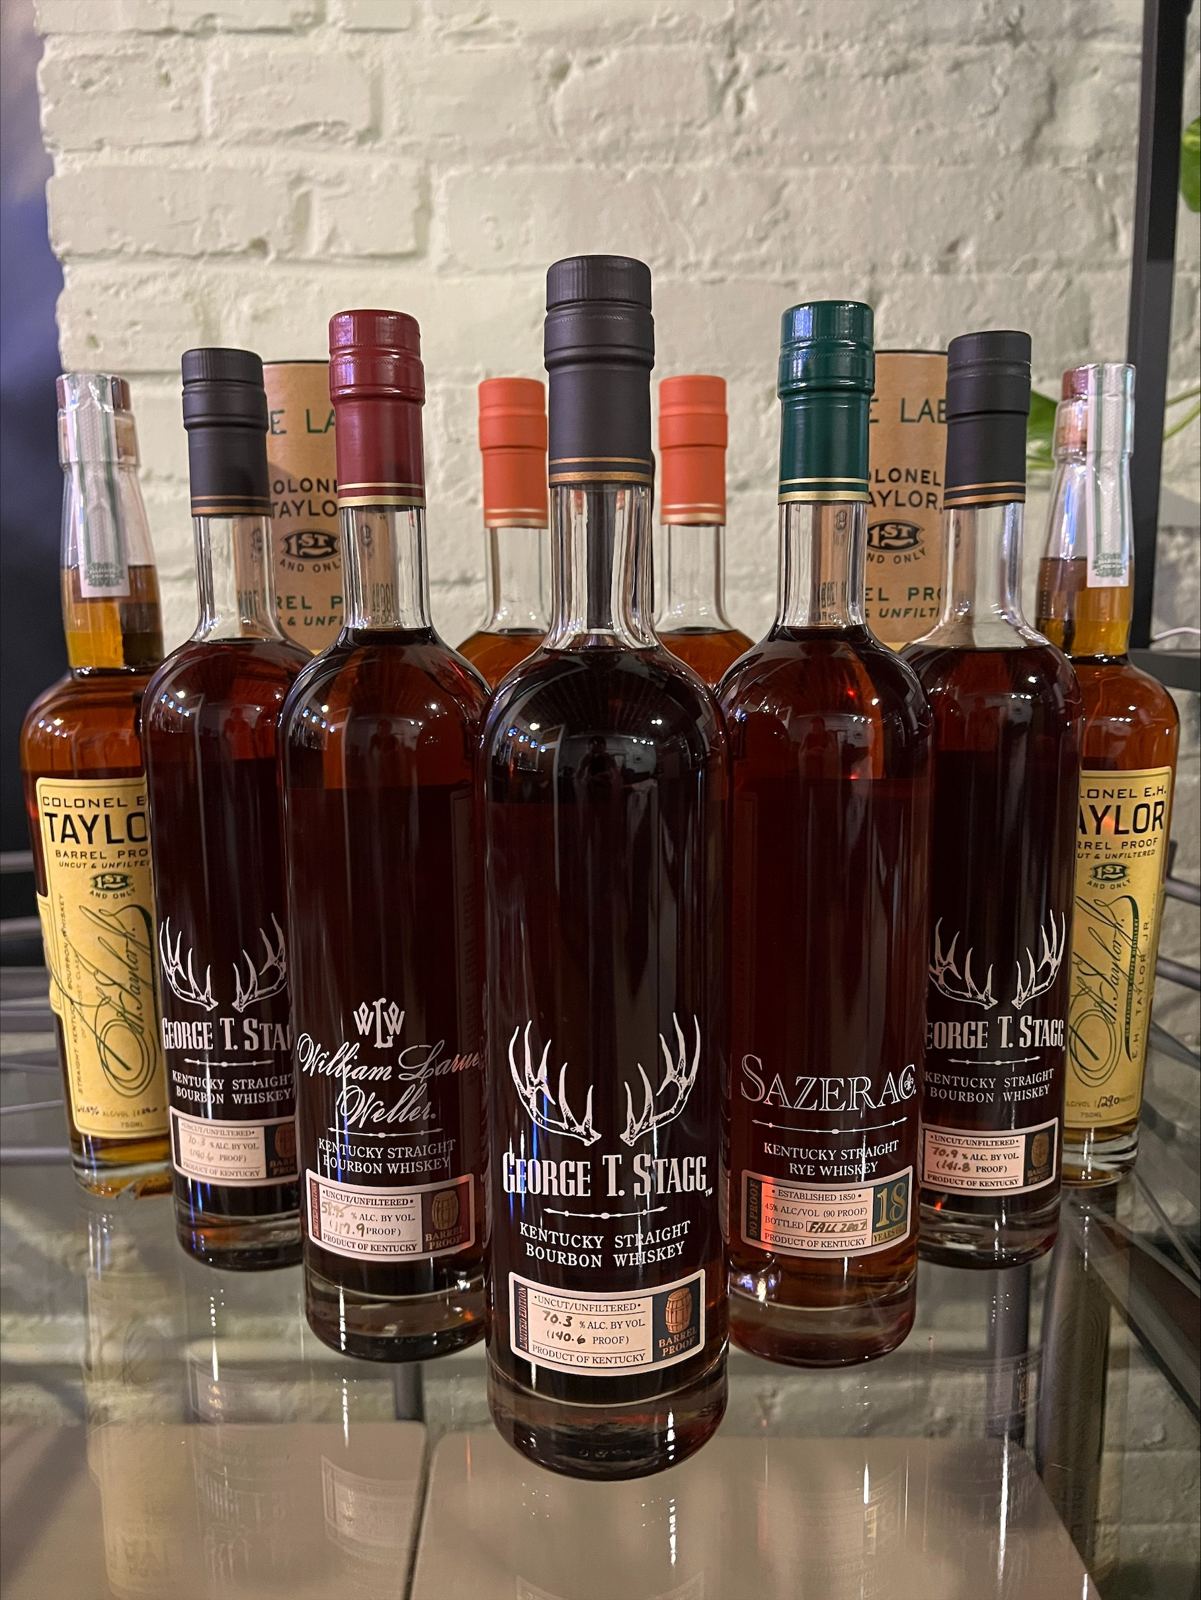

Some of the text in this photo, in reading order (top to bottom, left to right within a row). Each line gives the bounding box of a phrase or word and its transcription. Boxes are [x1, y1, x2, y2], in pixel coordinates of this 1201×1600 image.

[273, 477, 337, 494] OLON
[868, 467, 942, 487] LONEL
[894, 549, 927, 565] ONLY
[280, 559, 304, 573] AND
[288, 616, 296, 626] &
[42, 796, 128, 808] COLONEL
[44, 812, 148, 844] TAYLO
[1122, 838, 1158, 850] PROOF
[55, 849, 148, 860] BARREL PRO
[1105, 850, 1156, 859] UNFILTERED
[1086, 878, 1131, 890] AND ONLY
[90, 890, 107, 900] AND
[162, 1017, 214, 1050] GEORGE
[220, 1017, 238, 1050] T.
[998, 1016, 1014, 1048] T.
[296, 1032, 392, 1081] William
[172, 1070, 224, 1090] KENTUCKY
[740, 1054, 917, 1112] SAZERAC
[924, 1068, 1054, 1089] KENTUCKY STRAIGHT
[176, 1086, 292, 1104] BOURBON WHISKEY
[930, 1084, 1050, 1103] BOURBON WHISKEY
[318, 1138, 456, 1159] KENTUCKY STRAIGHT
[764, 1140, 900, 1161] KENTUCKY STRAIGHT
[970, 1153, 988, 1161] ALC.
[1002, 1152, 1020, 1160] VOL.
[209, 1168, 218, 1176] OF
[220, 1169, 260, 1177] KENTUCKY
[323, 1155, 450, 1174] BOURBON WHISKEY
[789, 1160, 878, 1176] RYE WHISKEY
[976, 1165, 1008, 1174] PROOF)
[502, 1152, 592, 1198] GEORGE
[602, 1154, 626, 1198] T.
[926, 1173, 1020, 1188] PRODUCT OF KENTUCKY
[326, 1189, 409, 1206] UNCUT/UNFILTERED
[778, 1190, 836, 1202] ESTABLISHED
[781, 1206, 820, 1218] ALC/VOL
[824, 1210, 835, 1218] (90
[838, 1208, 868, 1217] PROOF)
[876, 1182, 907, 1228] 18
[360, 1214, 378, 1222] ALC.
[381, 1214, 393, 1222] BY
[394, 1214, 416, 1222] VOL.
[765, 1216, 838, 1234] BOTTLED FALL
[366, 1227, 402, 1236] PROOF)
[520, 1220, 692, 1250] KENTUCKY STRAIGHT
[764, 1232, 866, 1248] PRODUCT OF KENTUCKY
[323, 1233, 418, 1252] PRODUCT OF KENTUCKY
[526, 1240, 686, 1268] BOURBON WHISKEY
[538, 1296, 636, 1312] UNCUT/UNFILTERED
[542, 1310, 573, 1328] 70.3
[587, 1322, 608, 1330] ALC.
[610, 1320, 624, 1330] BY
[592, 1336, 630, 1345] PROOF)
[658, 1326, 696, 1357] BARREL PROOF
[532, 1344, 646, 1364] PRODUCT OF KENTUCKY
